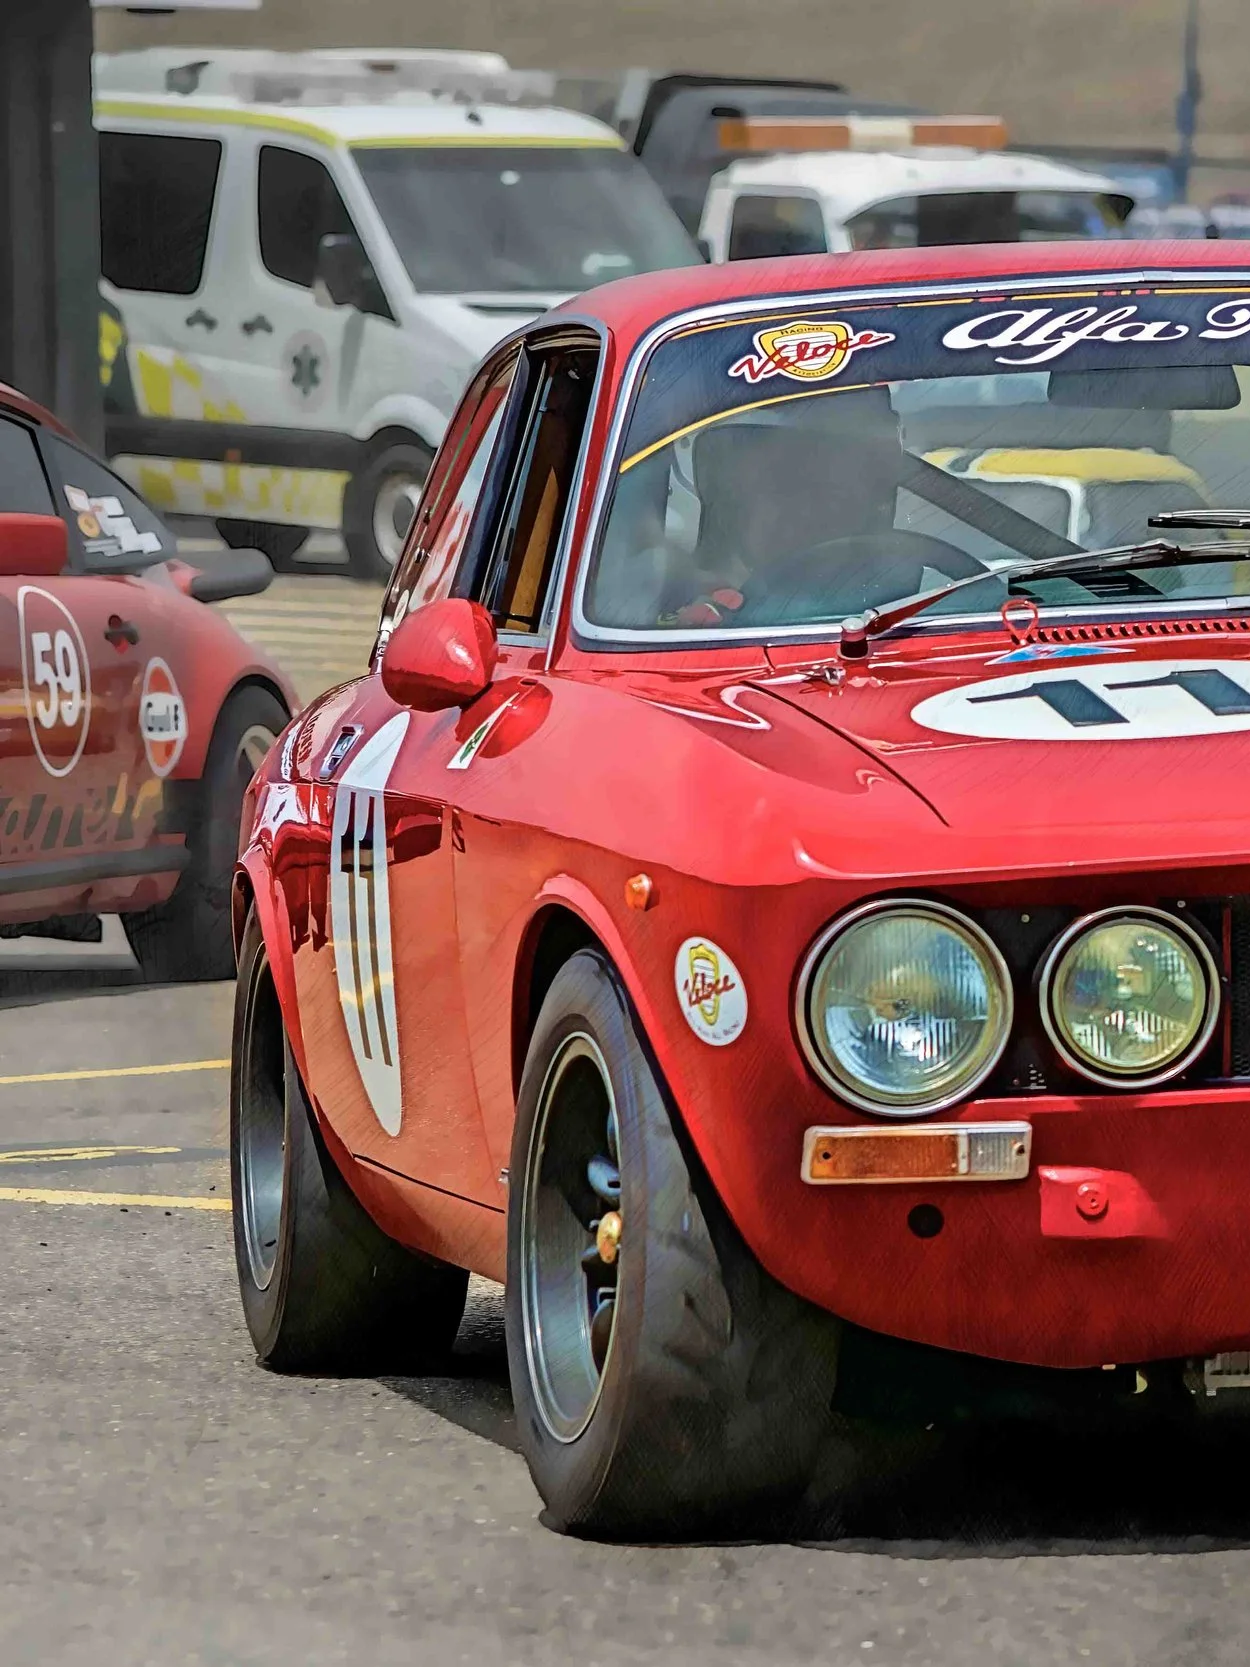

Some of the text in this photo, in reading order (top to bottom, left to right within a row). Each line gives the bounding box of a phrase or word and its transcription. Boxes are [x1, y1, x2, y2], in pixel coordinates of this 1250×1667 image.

[733, 333, 890, 380] Veloce
[942, 304, 1190, 364] Alfa
[31, 629, 82, 729] 59
